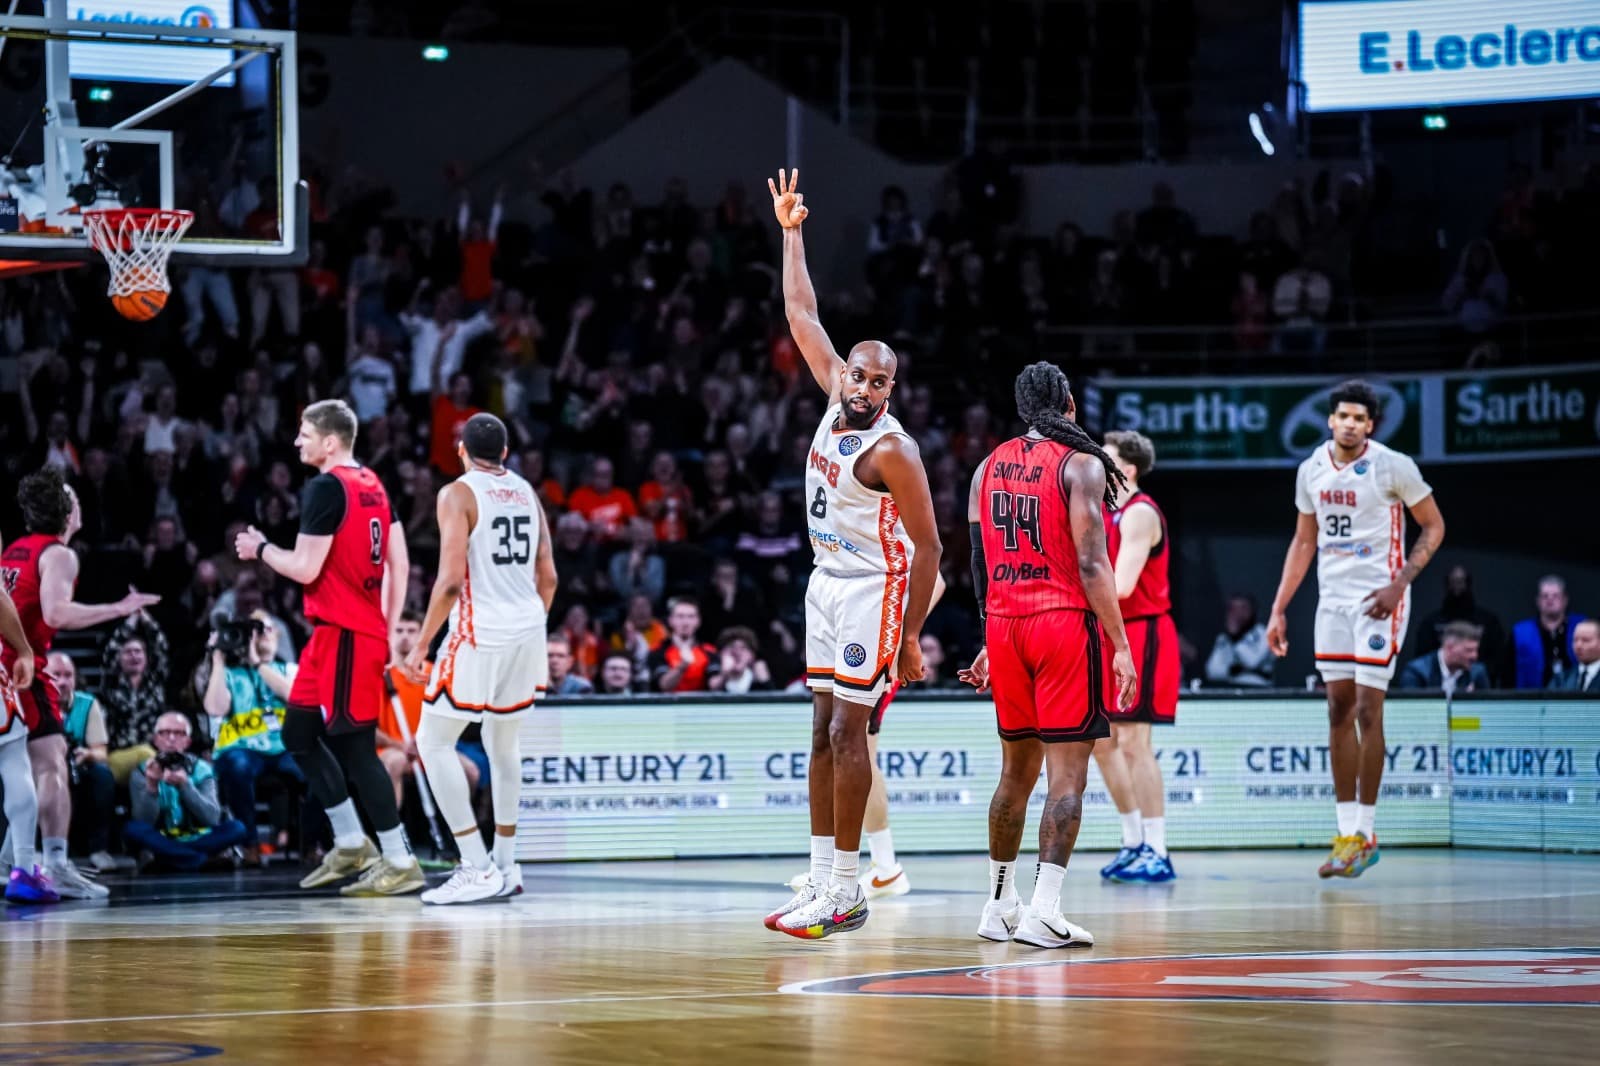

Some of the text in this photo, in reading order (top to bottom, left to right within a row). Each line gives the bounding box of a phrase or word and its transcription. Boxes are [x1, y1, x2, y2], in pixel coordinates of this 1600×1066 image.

[1359, 23, 1600, 74] E.Leclerc
[1115, 392, 1268, 431] Sarthe
[1457, 380, 1585, 425] Sarthe
[810, 486, 828, 519] 8
[990, 490, 1045, 556] 44
[1325, 514, 1352, 537] 32
[491, 515, 531, 566] 35
[992, 562, 1051, 585] OlyBet
[521, 753, 687, 784] CENTURY
[765, 751, 929, 779] CERY
[1246, 745, 1405, 772] CENTY
[1454, 747, 1550, 776] CENTURY
